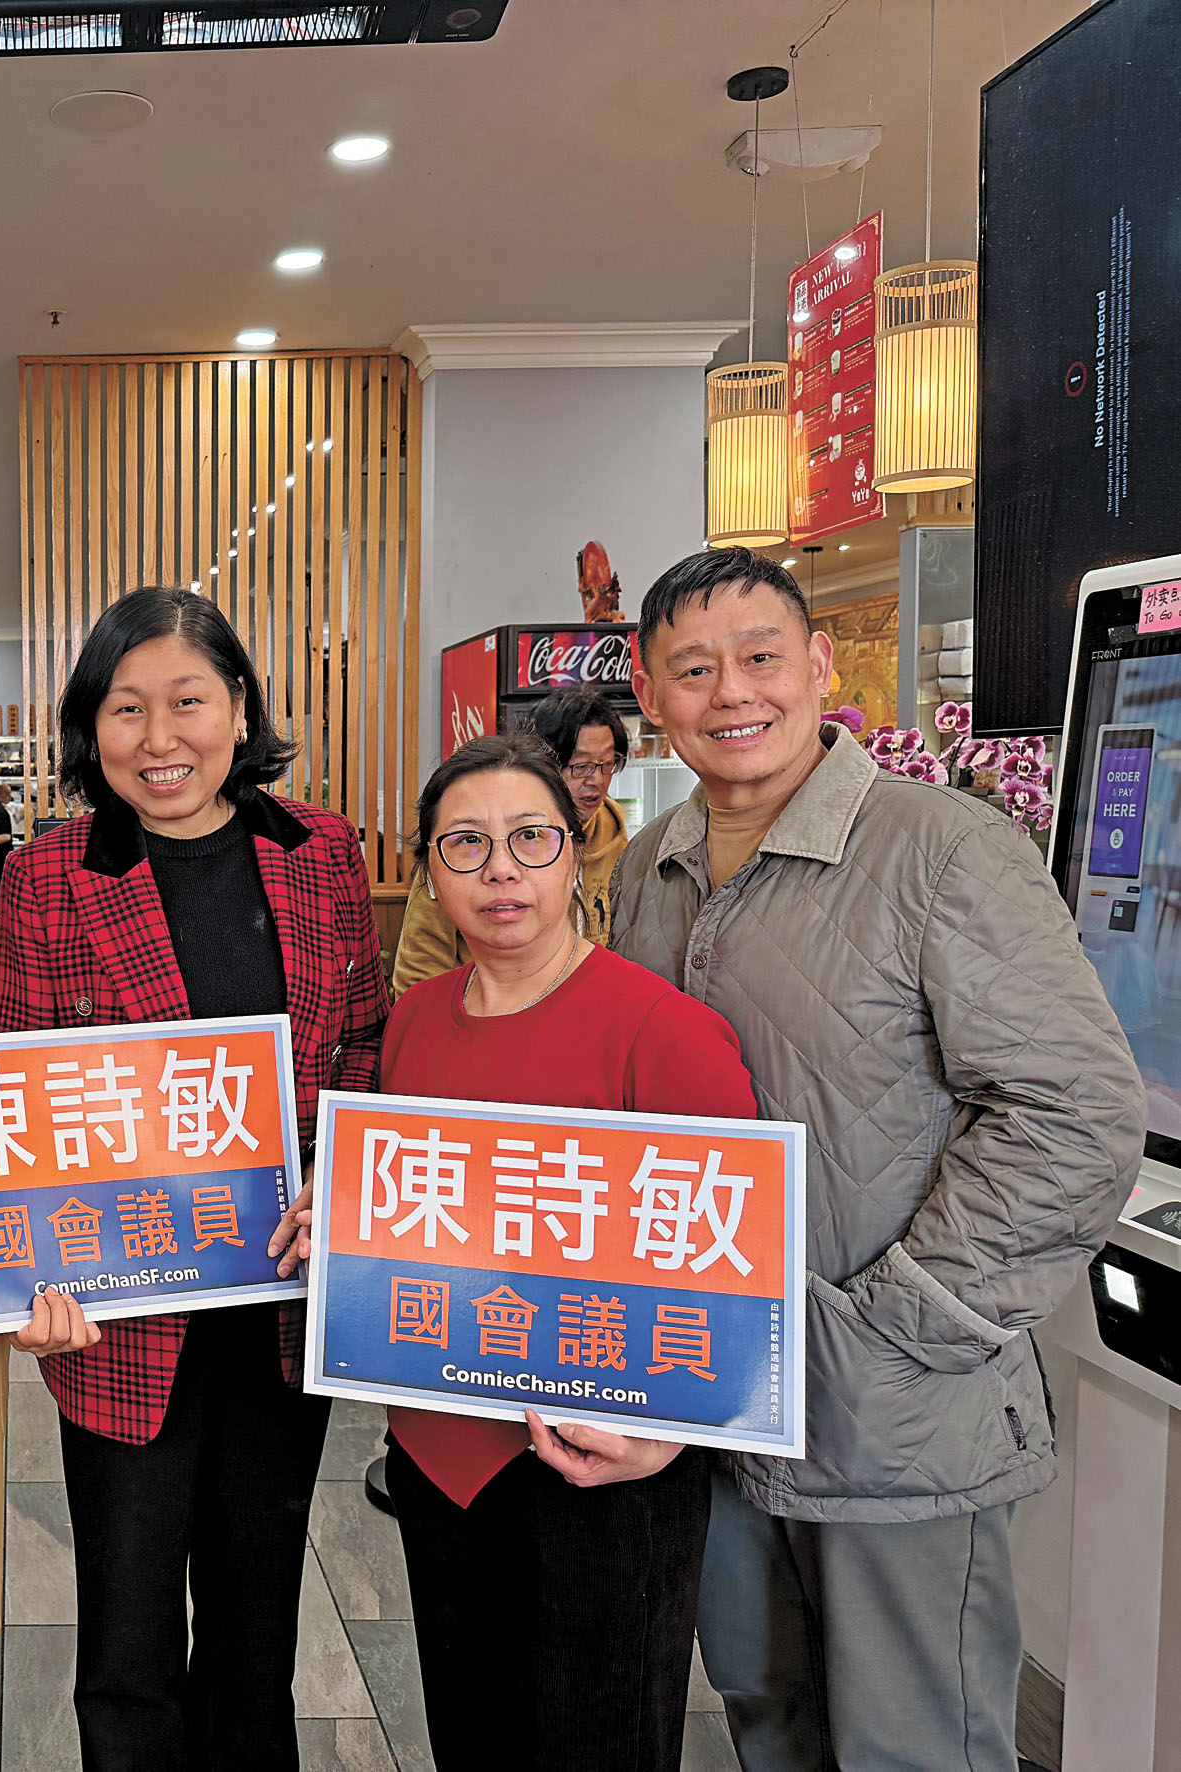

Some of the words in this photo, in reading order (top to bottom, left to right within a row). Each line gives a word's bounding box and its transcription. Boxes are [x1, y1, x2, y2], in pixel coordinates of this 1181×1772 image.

[811, 262, 833, 289] NEW
[811, 270, 853, 307] ARRIVAL
[1095, 289, 1106, 359] Detected
[1094, 359, 1105, 424] Network
[1094, 425, 1104, 448] No
[1122, 444, 1128, 456] TV
[1107, 771, 1140, 782] ORDER
[1118, 787, 1134, 797] PAY
[1103, 803, 1137, 817] HERE
[358, 1127, 755, 1278] 陳詩敏
[388, 1274, 718, 1382] 國會議員
[441, 1362, 648, 1406] ConnieChanSF.com
